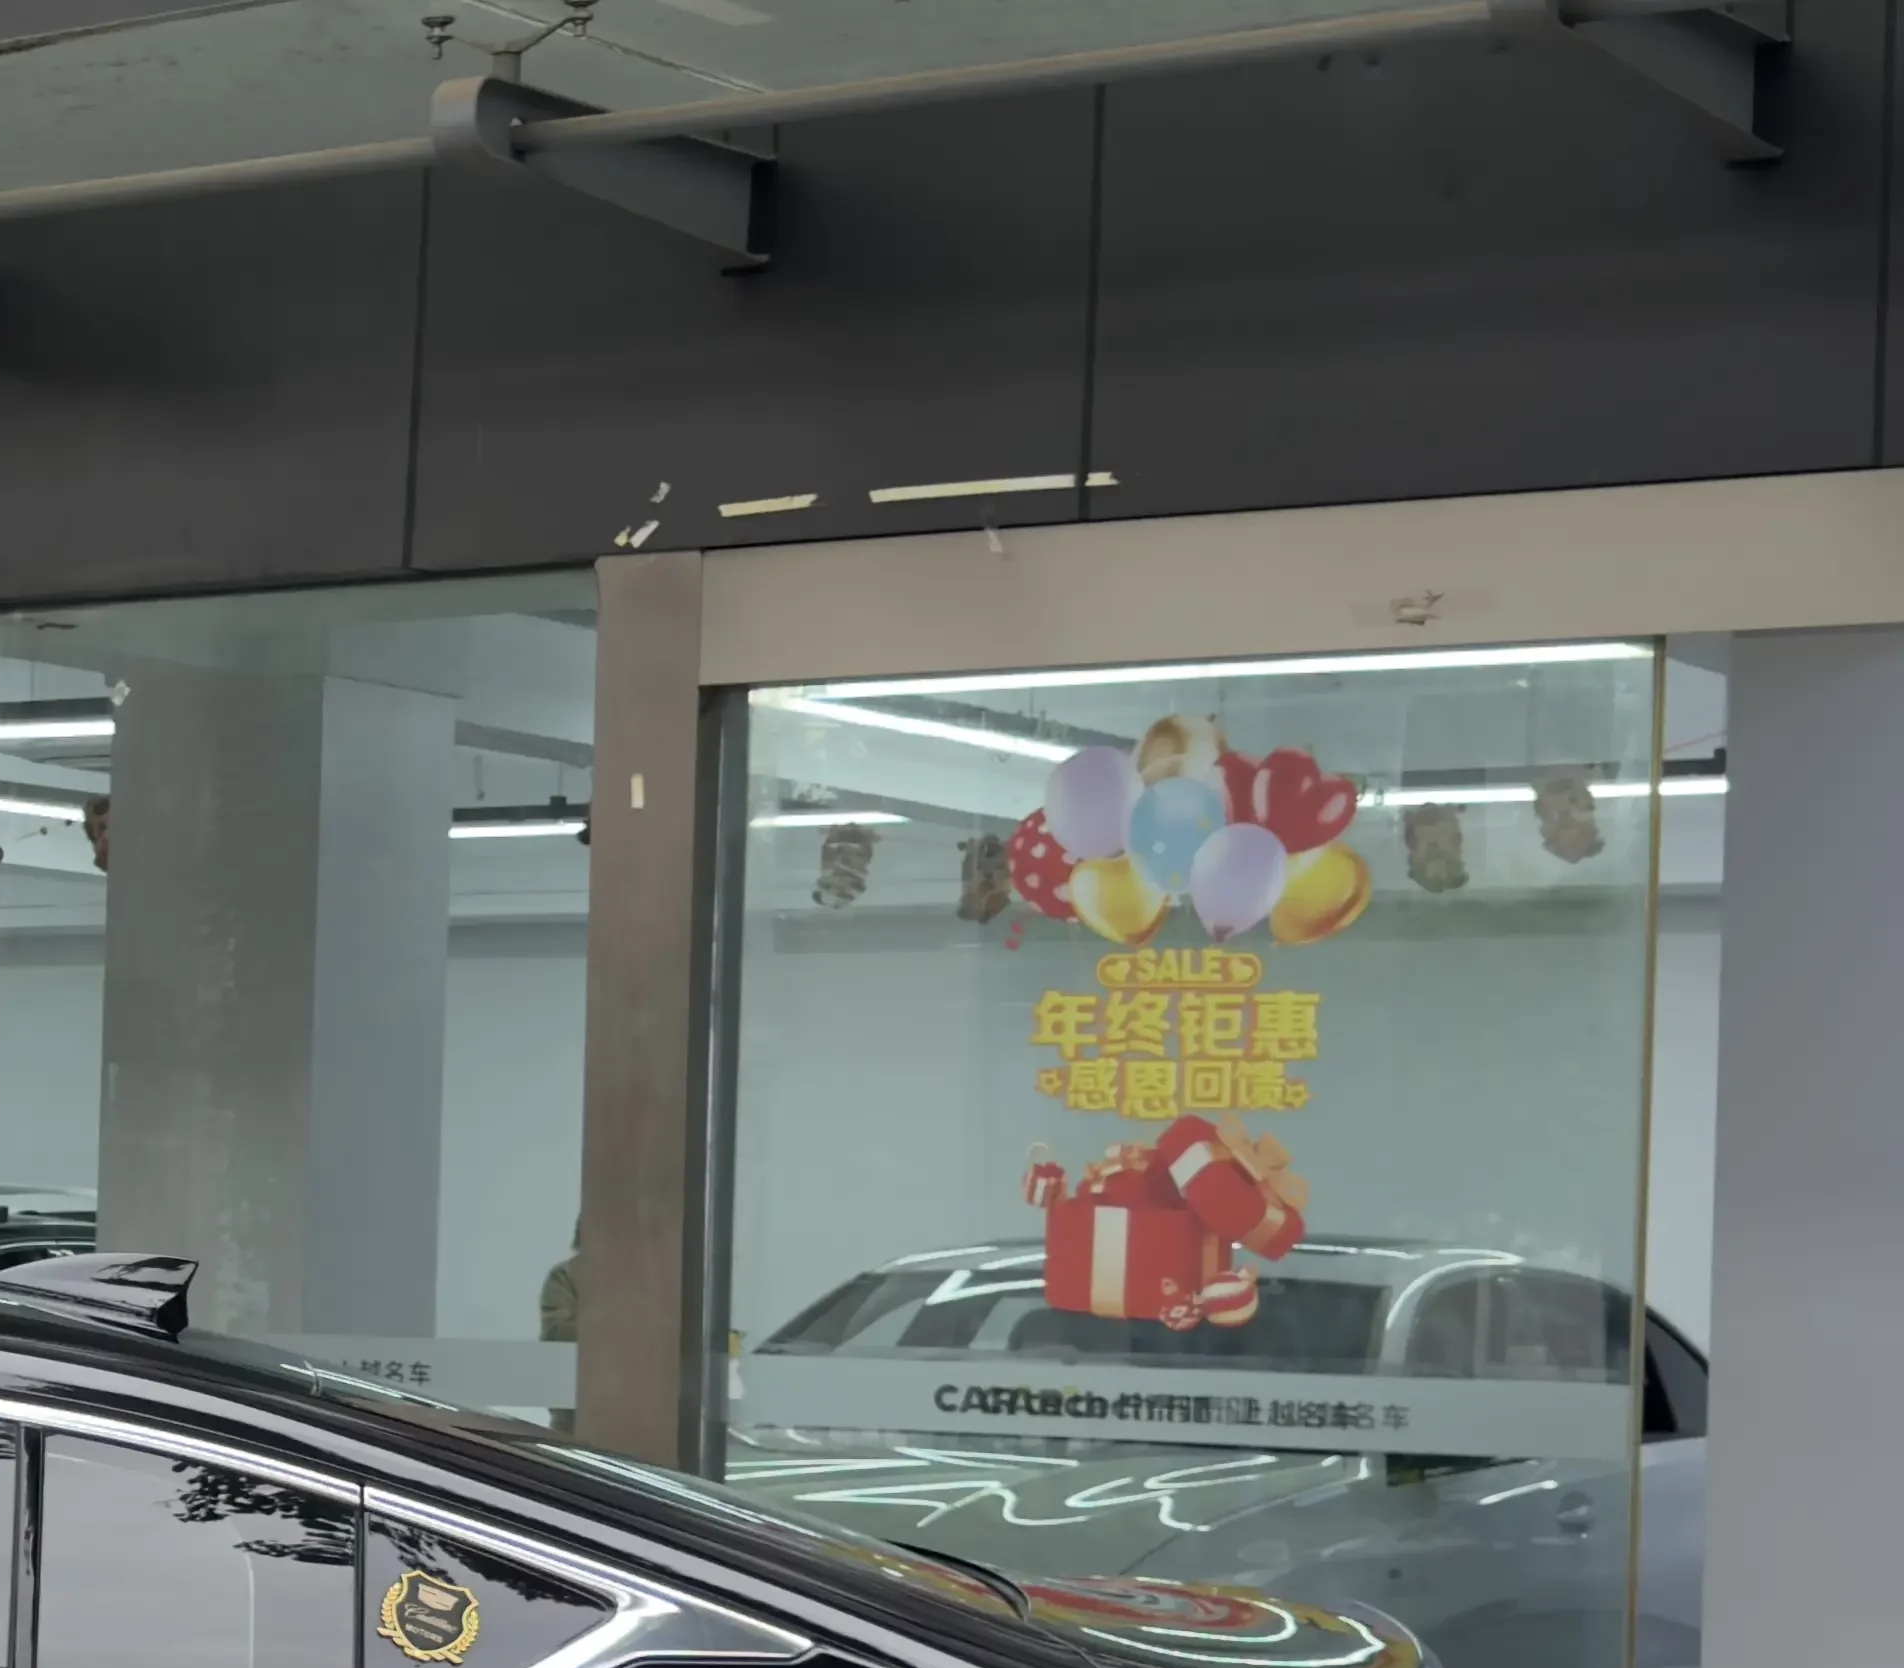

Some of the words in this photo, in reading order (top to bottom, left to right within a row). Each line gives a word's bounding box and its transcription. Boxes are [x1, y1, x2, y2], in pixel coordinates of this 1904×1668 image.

[1135, 948, 1223, 984] SALE
[1033, 989, 1321, 1060] 年终钜惠
[1065, 1058, 1289, 1120] 感恩回馈
